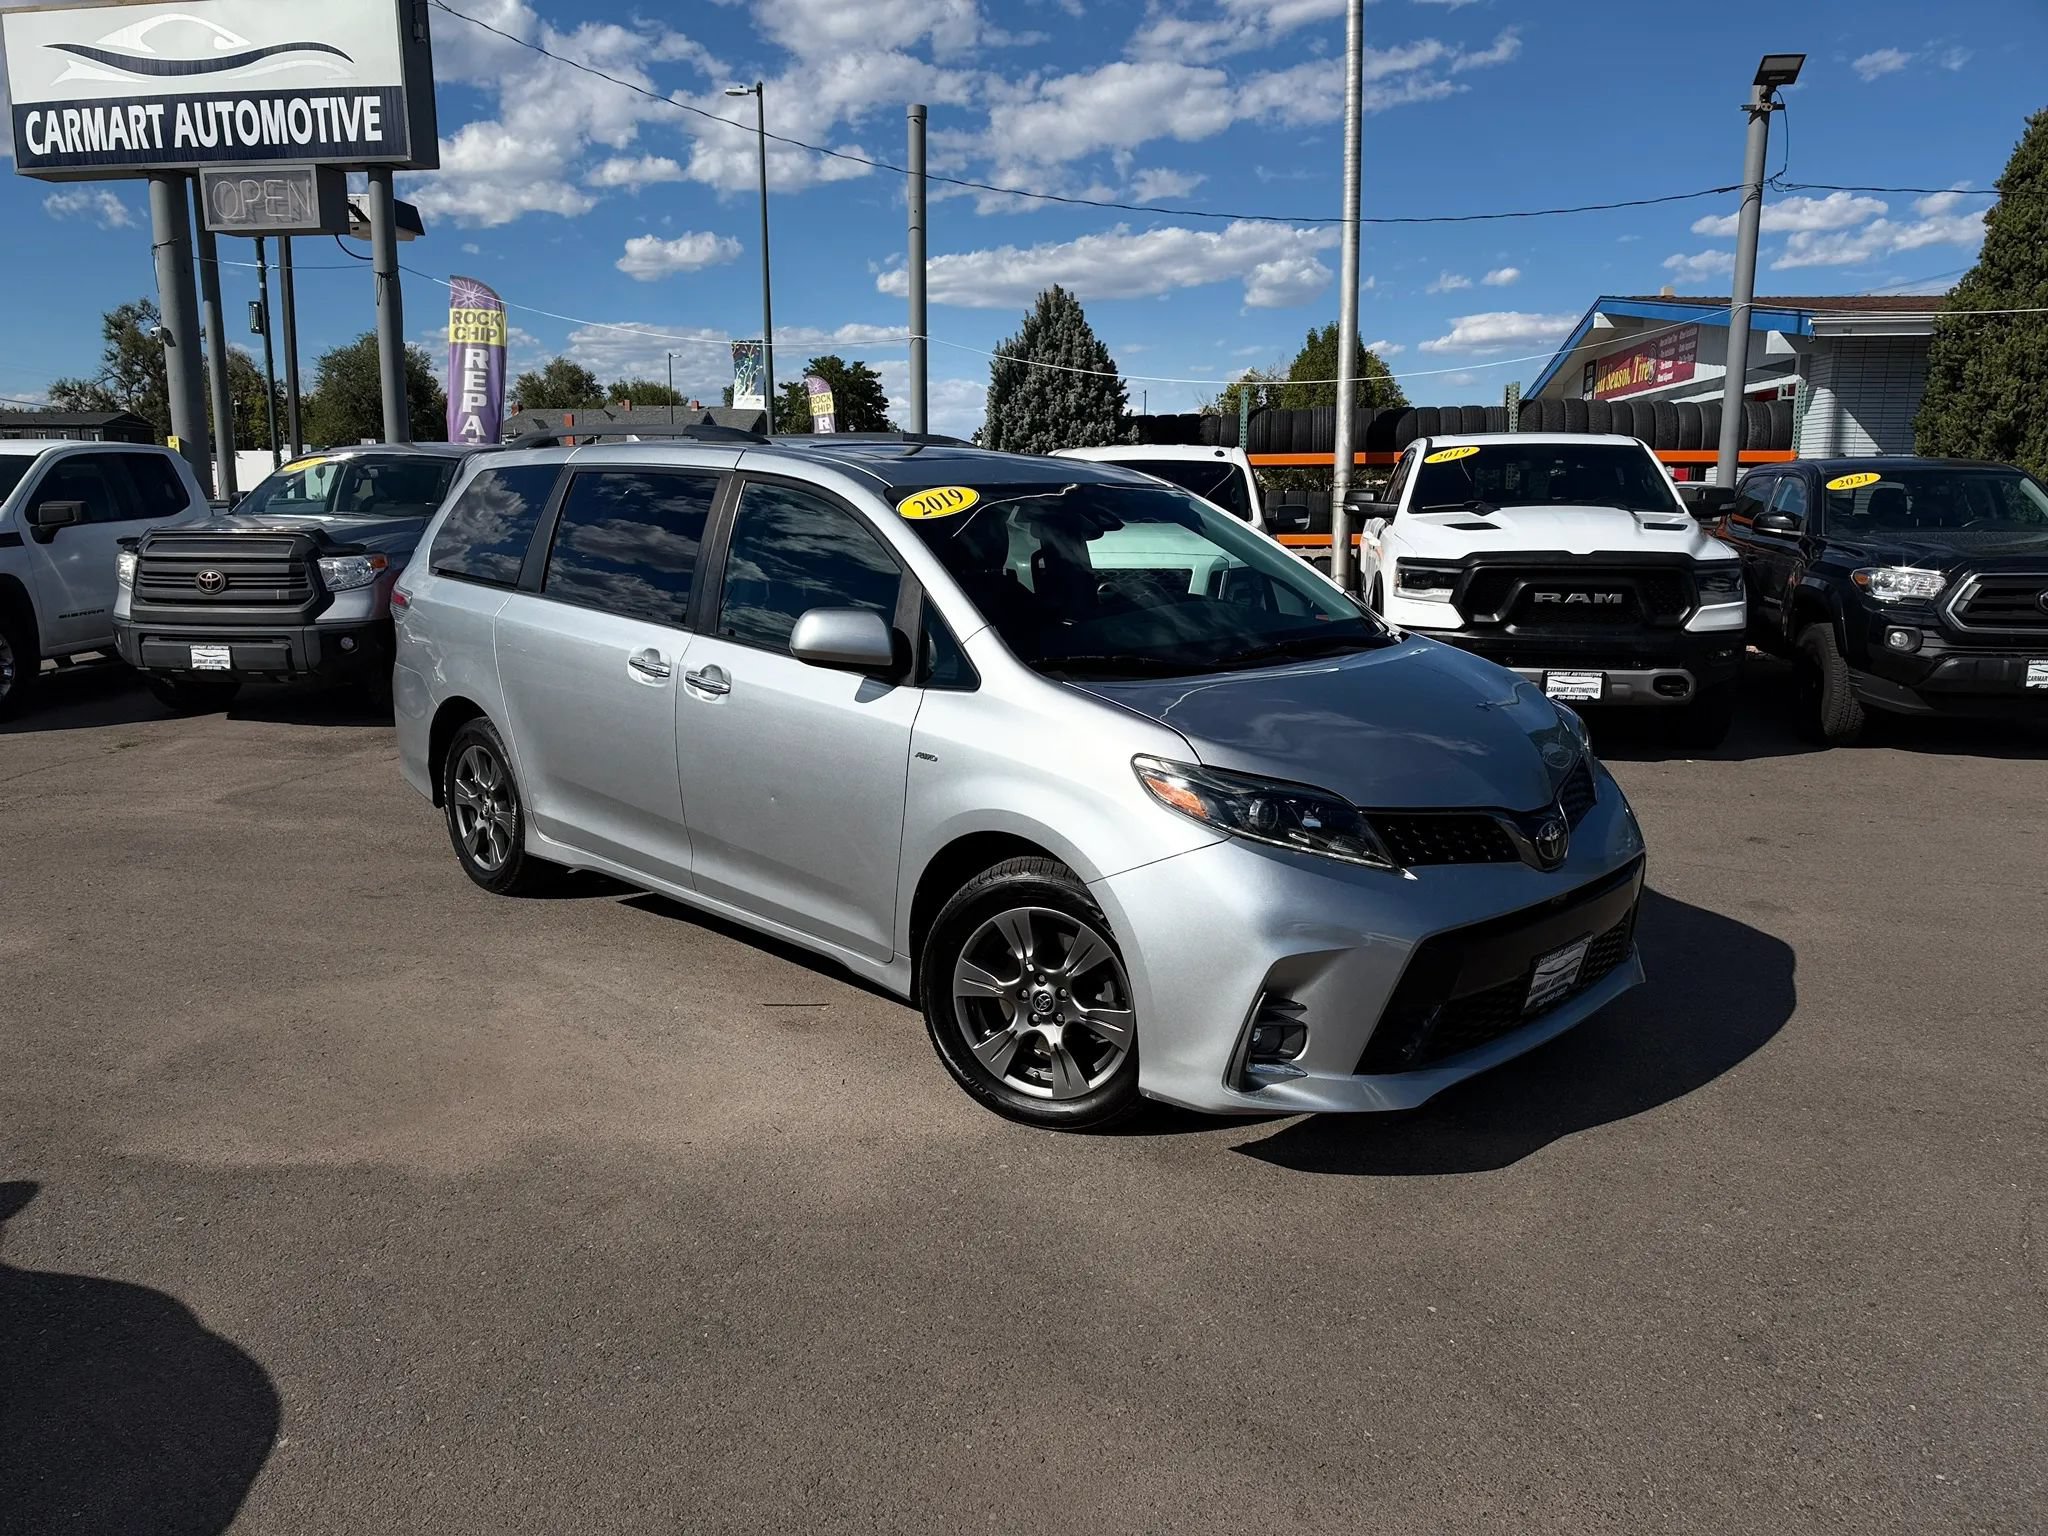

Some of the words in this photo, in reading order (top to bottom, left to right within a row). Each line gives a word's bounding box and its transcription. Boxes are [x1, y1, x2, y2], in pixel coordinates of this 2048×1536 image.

[25, 103, 165, 156] CARMART
[174, 95, 383, 148] AUTOMOTIVE
[212, 179, 312, 219] OPEN
[452, 310, 501, 328] ROCK
[453, 326, 498, 342] CHIP
[810, 394, 832, 405] ROCK
[812, 403, 832, 414] CHIP
[1435, 447, 1471, 461] 2019
[1838, 474, 1869, 488] 2021
[912, 488, 964, 516] 2019
[1534, 592, 1622, 604] RAM
